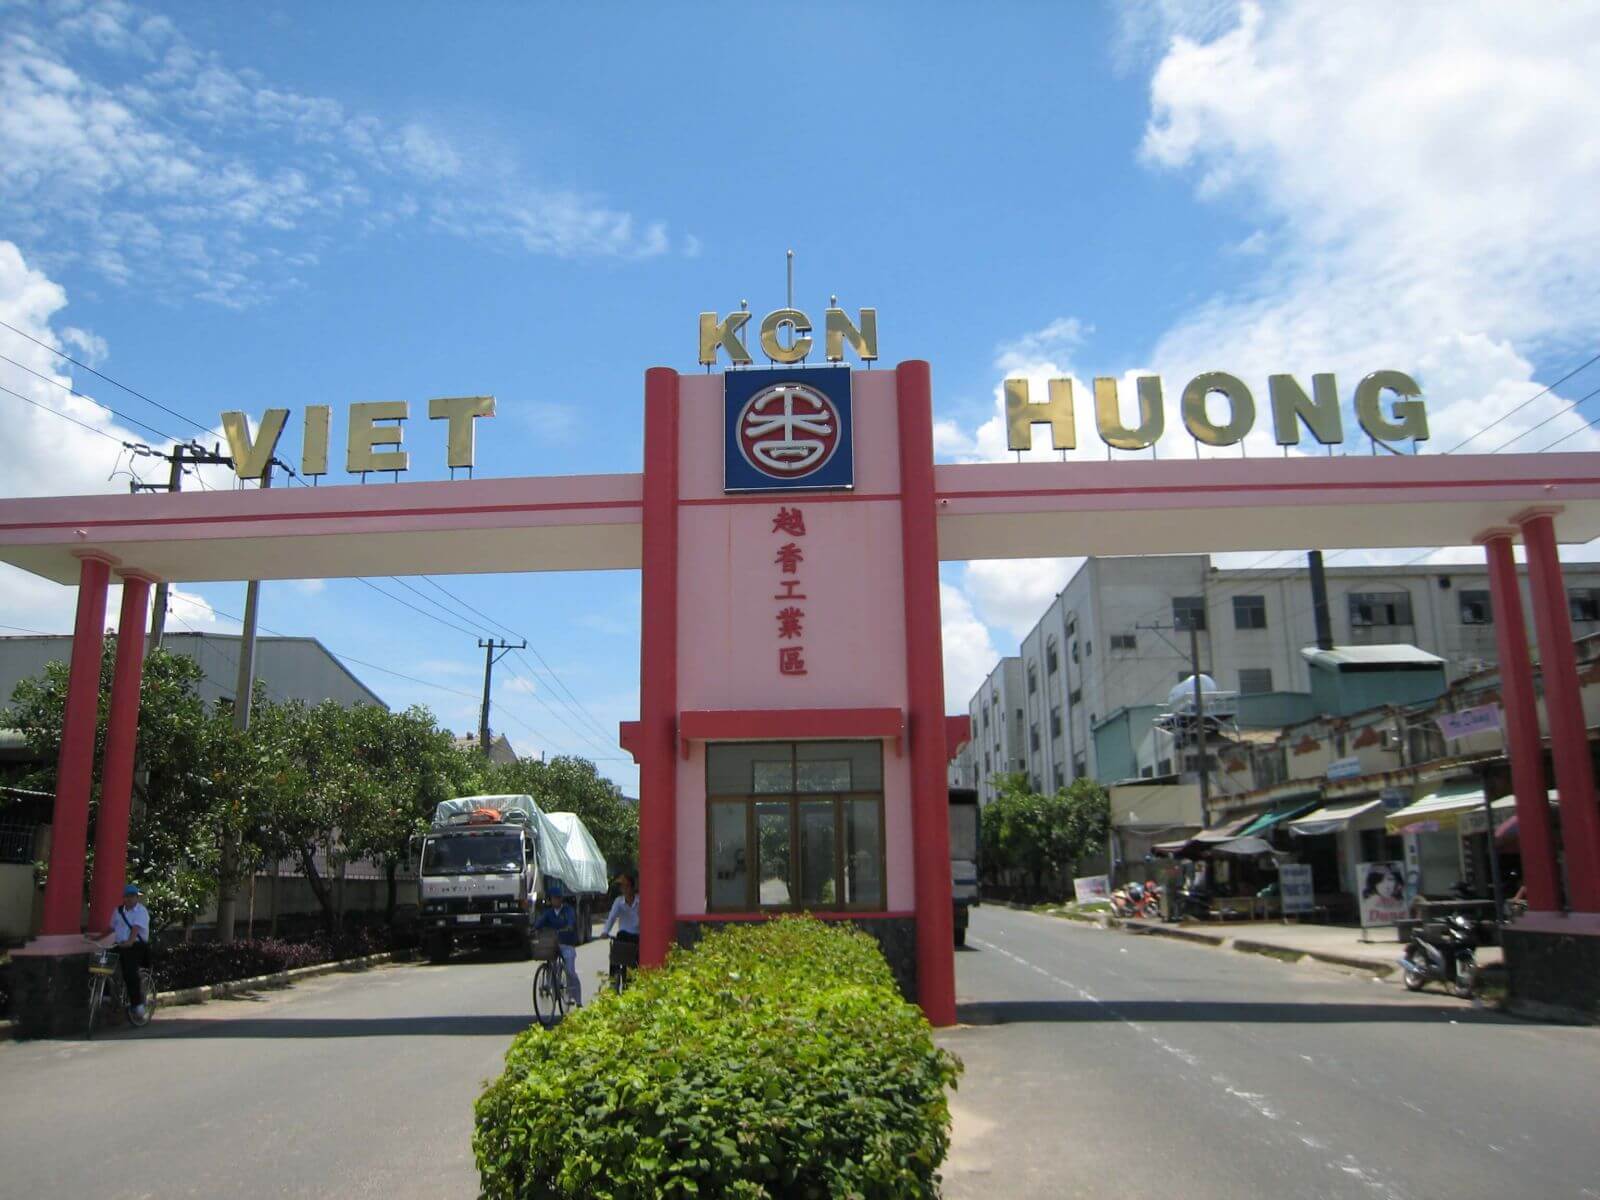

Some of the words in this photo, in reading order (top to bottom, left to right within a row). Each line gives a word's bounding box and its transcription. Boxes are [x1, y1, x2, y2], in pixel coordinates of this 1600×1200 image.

[699, 307, 879, 365] KCN
[220, 396, 497, 479] VIET
[1003, 370, 1430, 451] HUONG
[771, 506, 808, 676] 越香工業區
